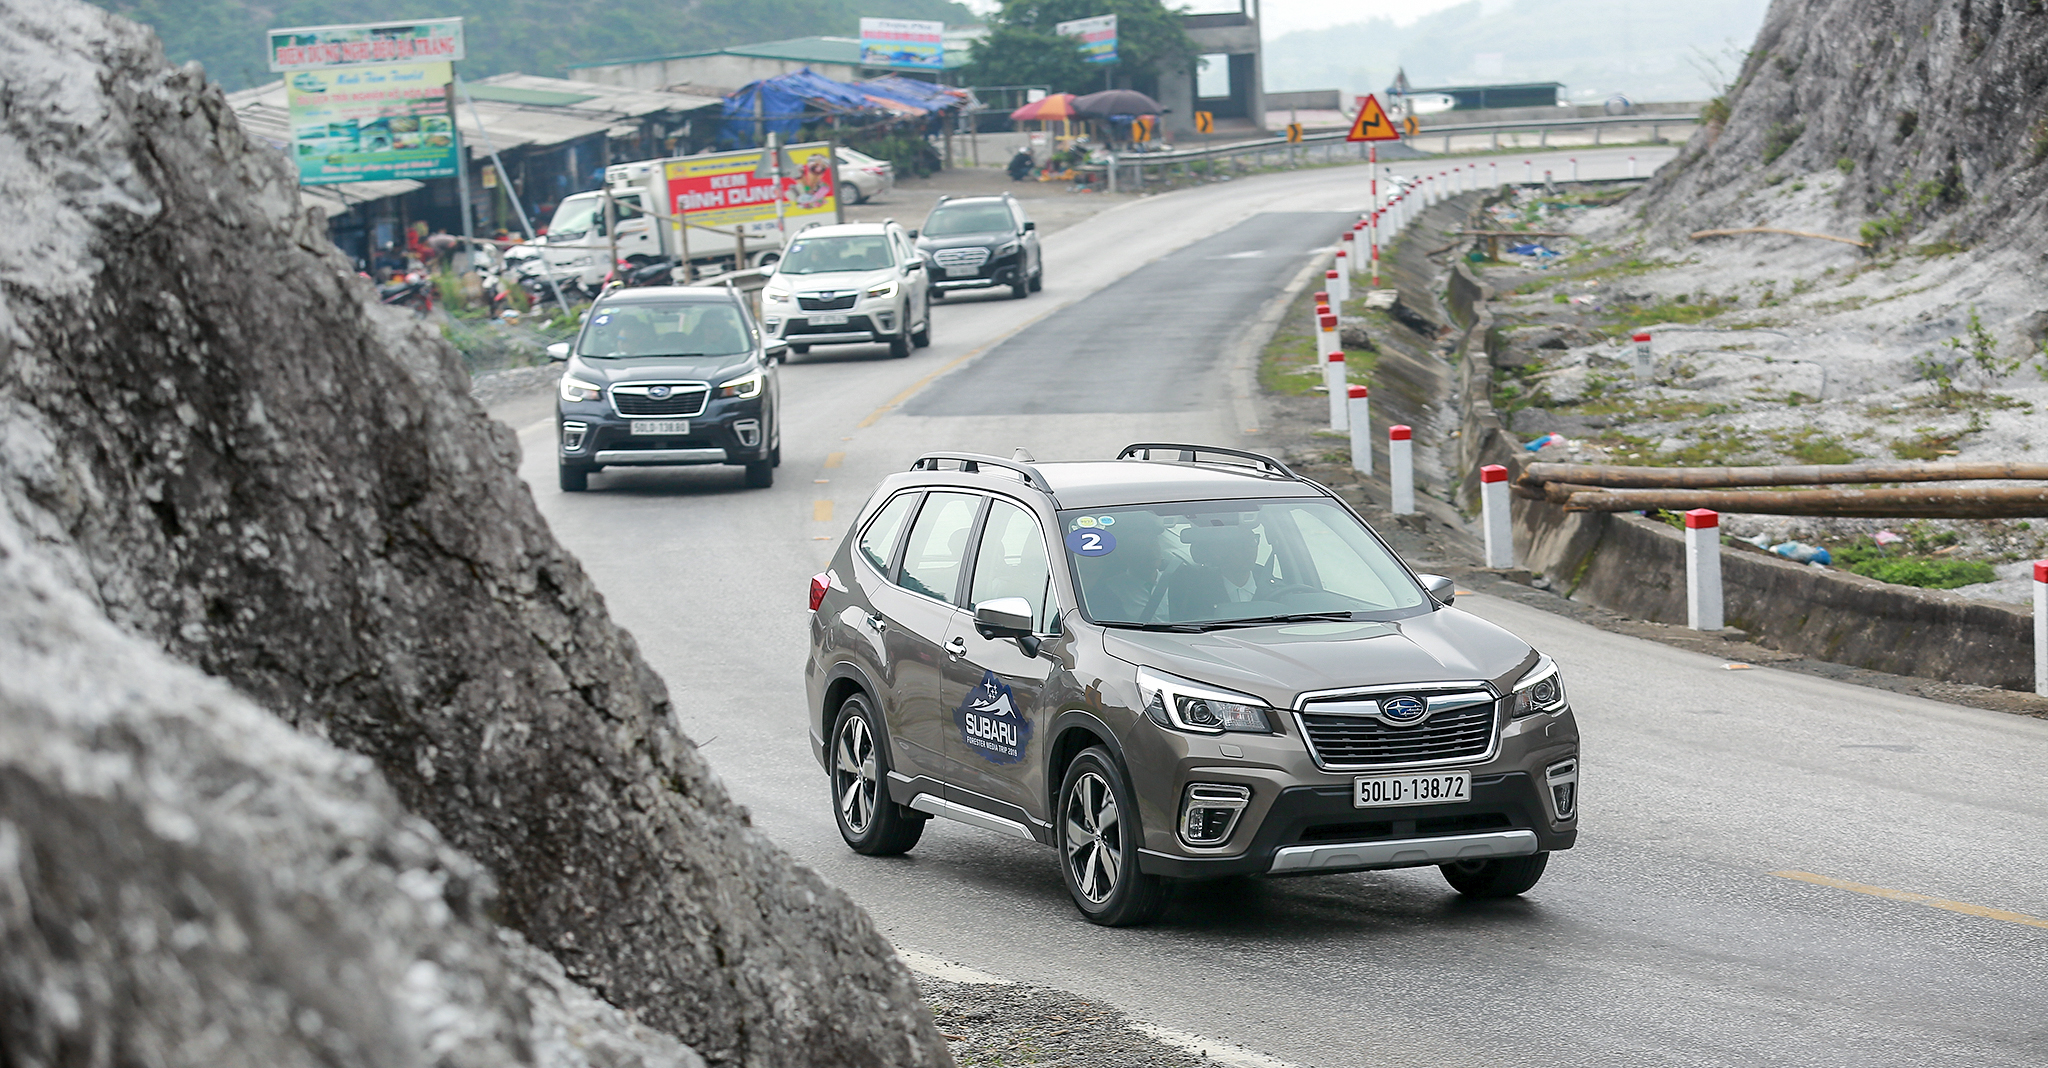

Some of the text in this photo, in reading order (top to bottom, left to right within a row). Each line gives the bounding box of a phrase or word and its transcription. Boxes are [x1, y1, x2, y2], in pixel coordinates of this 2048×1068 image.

[710, 174, 748, 189] KEM
[1081, 533, 1103, 551] 2
[966, 713, 1016, 746] SUBARU
[967, 736, 985, 747] FORESTER
[986, 742, 998, 751] MEDIA
[999, 745, 1007, 753] TRIP
[1362, 777, 1463, 802] 50LD-138.72
